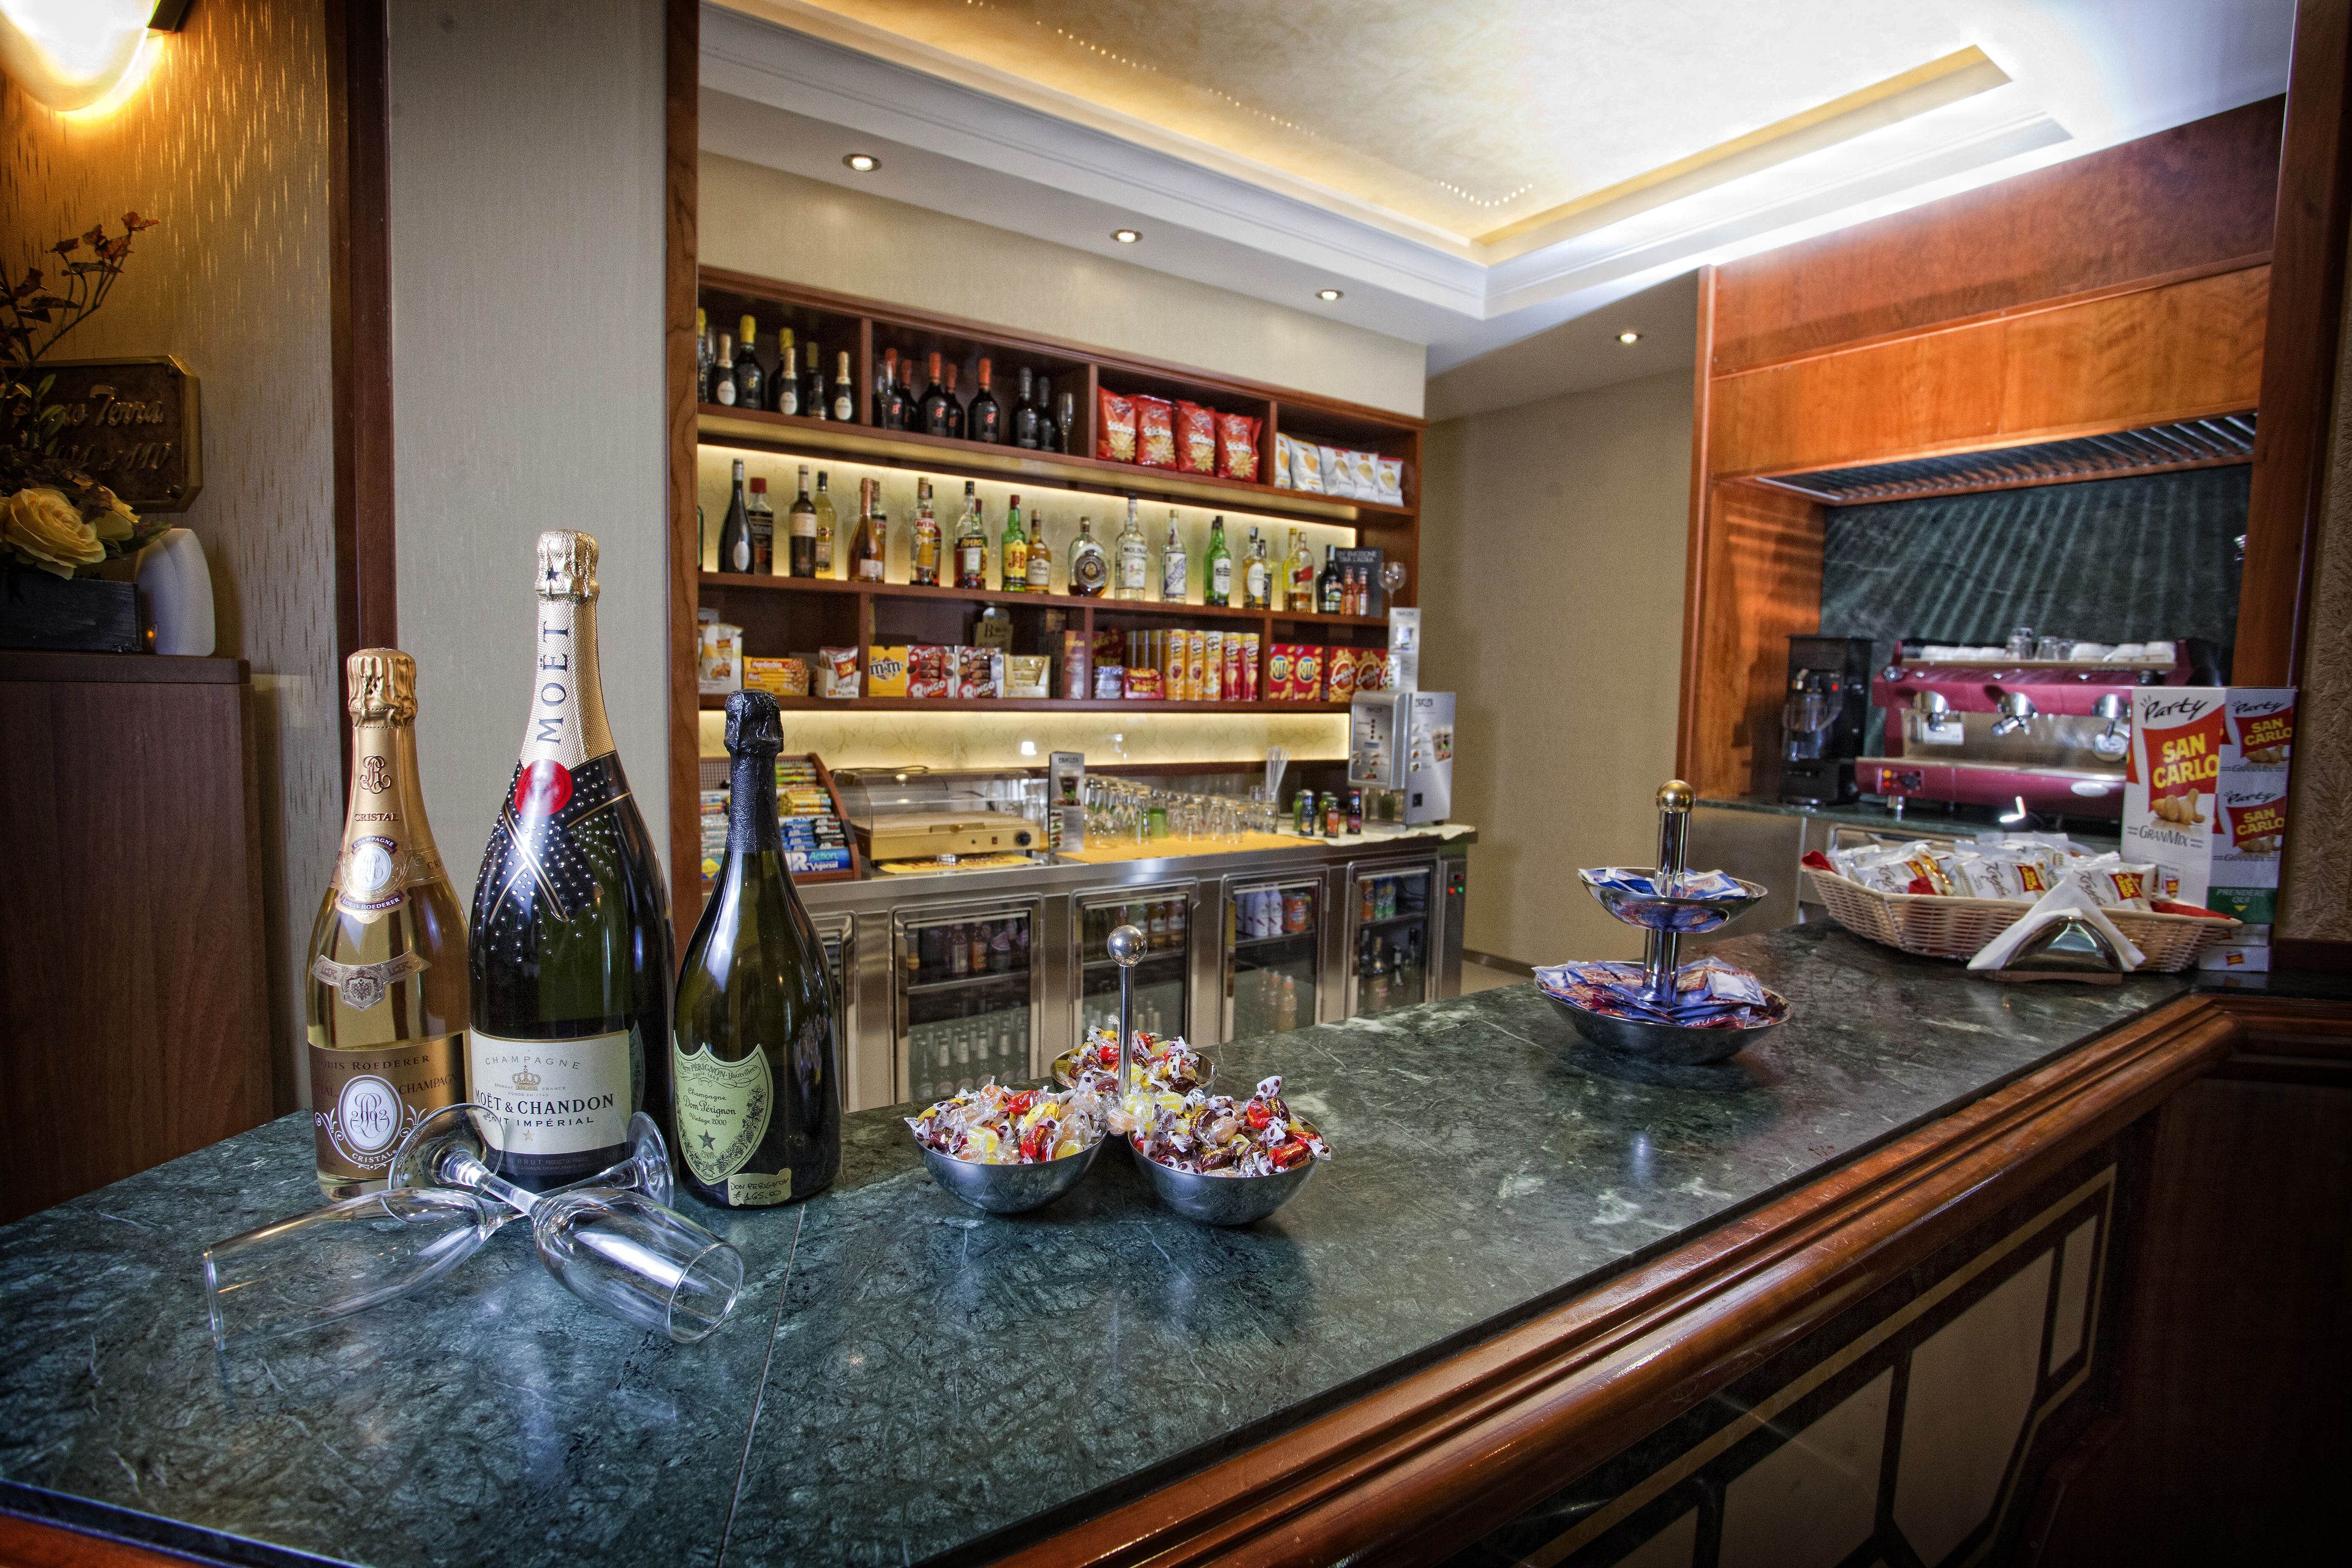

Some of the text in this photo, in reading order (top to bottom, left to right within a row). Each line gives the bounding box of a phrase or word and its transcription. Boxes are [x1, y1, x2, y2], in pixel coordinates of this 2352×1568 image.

[536, 620, 569, 744] MOËT
[2144, 699, 2209, 723] Party
[2233, 700, 2285, 714] Party
[2251, 717, 2285, 734] SAN
[2244, 726, 2293, 746] CARLO
[2162, 733, 2206, 764] SAN
[2152, 754, 2220, 789] CARLO
[2227, 791, 2278, 805] Party
[354, 813, 399, 821] CRISTAL
[2243, 808, 2275, 824] SAN
[2236, 816, 2285, 837] CARLO
[353, 836, 394, 848] CHAMPAGNE
[2215, 888, 2266, 897] PRENDERE
[342, 897, 401, 910] LOUIS ROEDERER
[2231, 896, 2251, 905] QUI
[352, 1055, 429, 1071] ROEDERER
[486, 1055, 581, 1069] CHAMPAGNE
[690, 1062, 726, 1079] PÉRIGNON
[728, 1066, 758, 1079] Hautvillers
[475, 1087, 614, 1115] MOËT & CHANDON
[688, 1087, 727, 1102] Champagne
[683, 1095, 736, 1120] Dom Pérignon
[351, 1109, 388, 1123] 2002
[517, 1117, 594, 1127] IMPÉRIAL
[689, 1113, 710, 1126] Vintage
[352, 1152, 393, 1164] CRISTAL
[729, 1177, 790, 1191] DON PERIGNON
[733, 1189, 782, 1201] € 165.00
